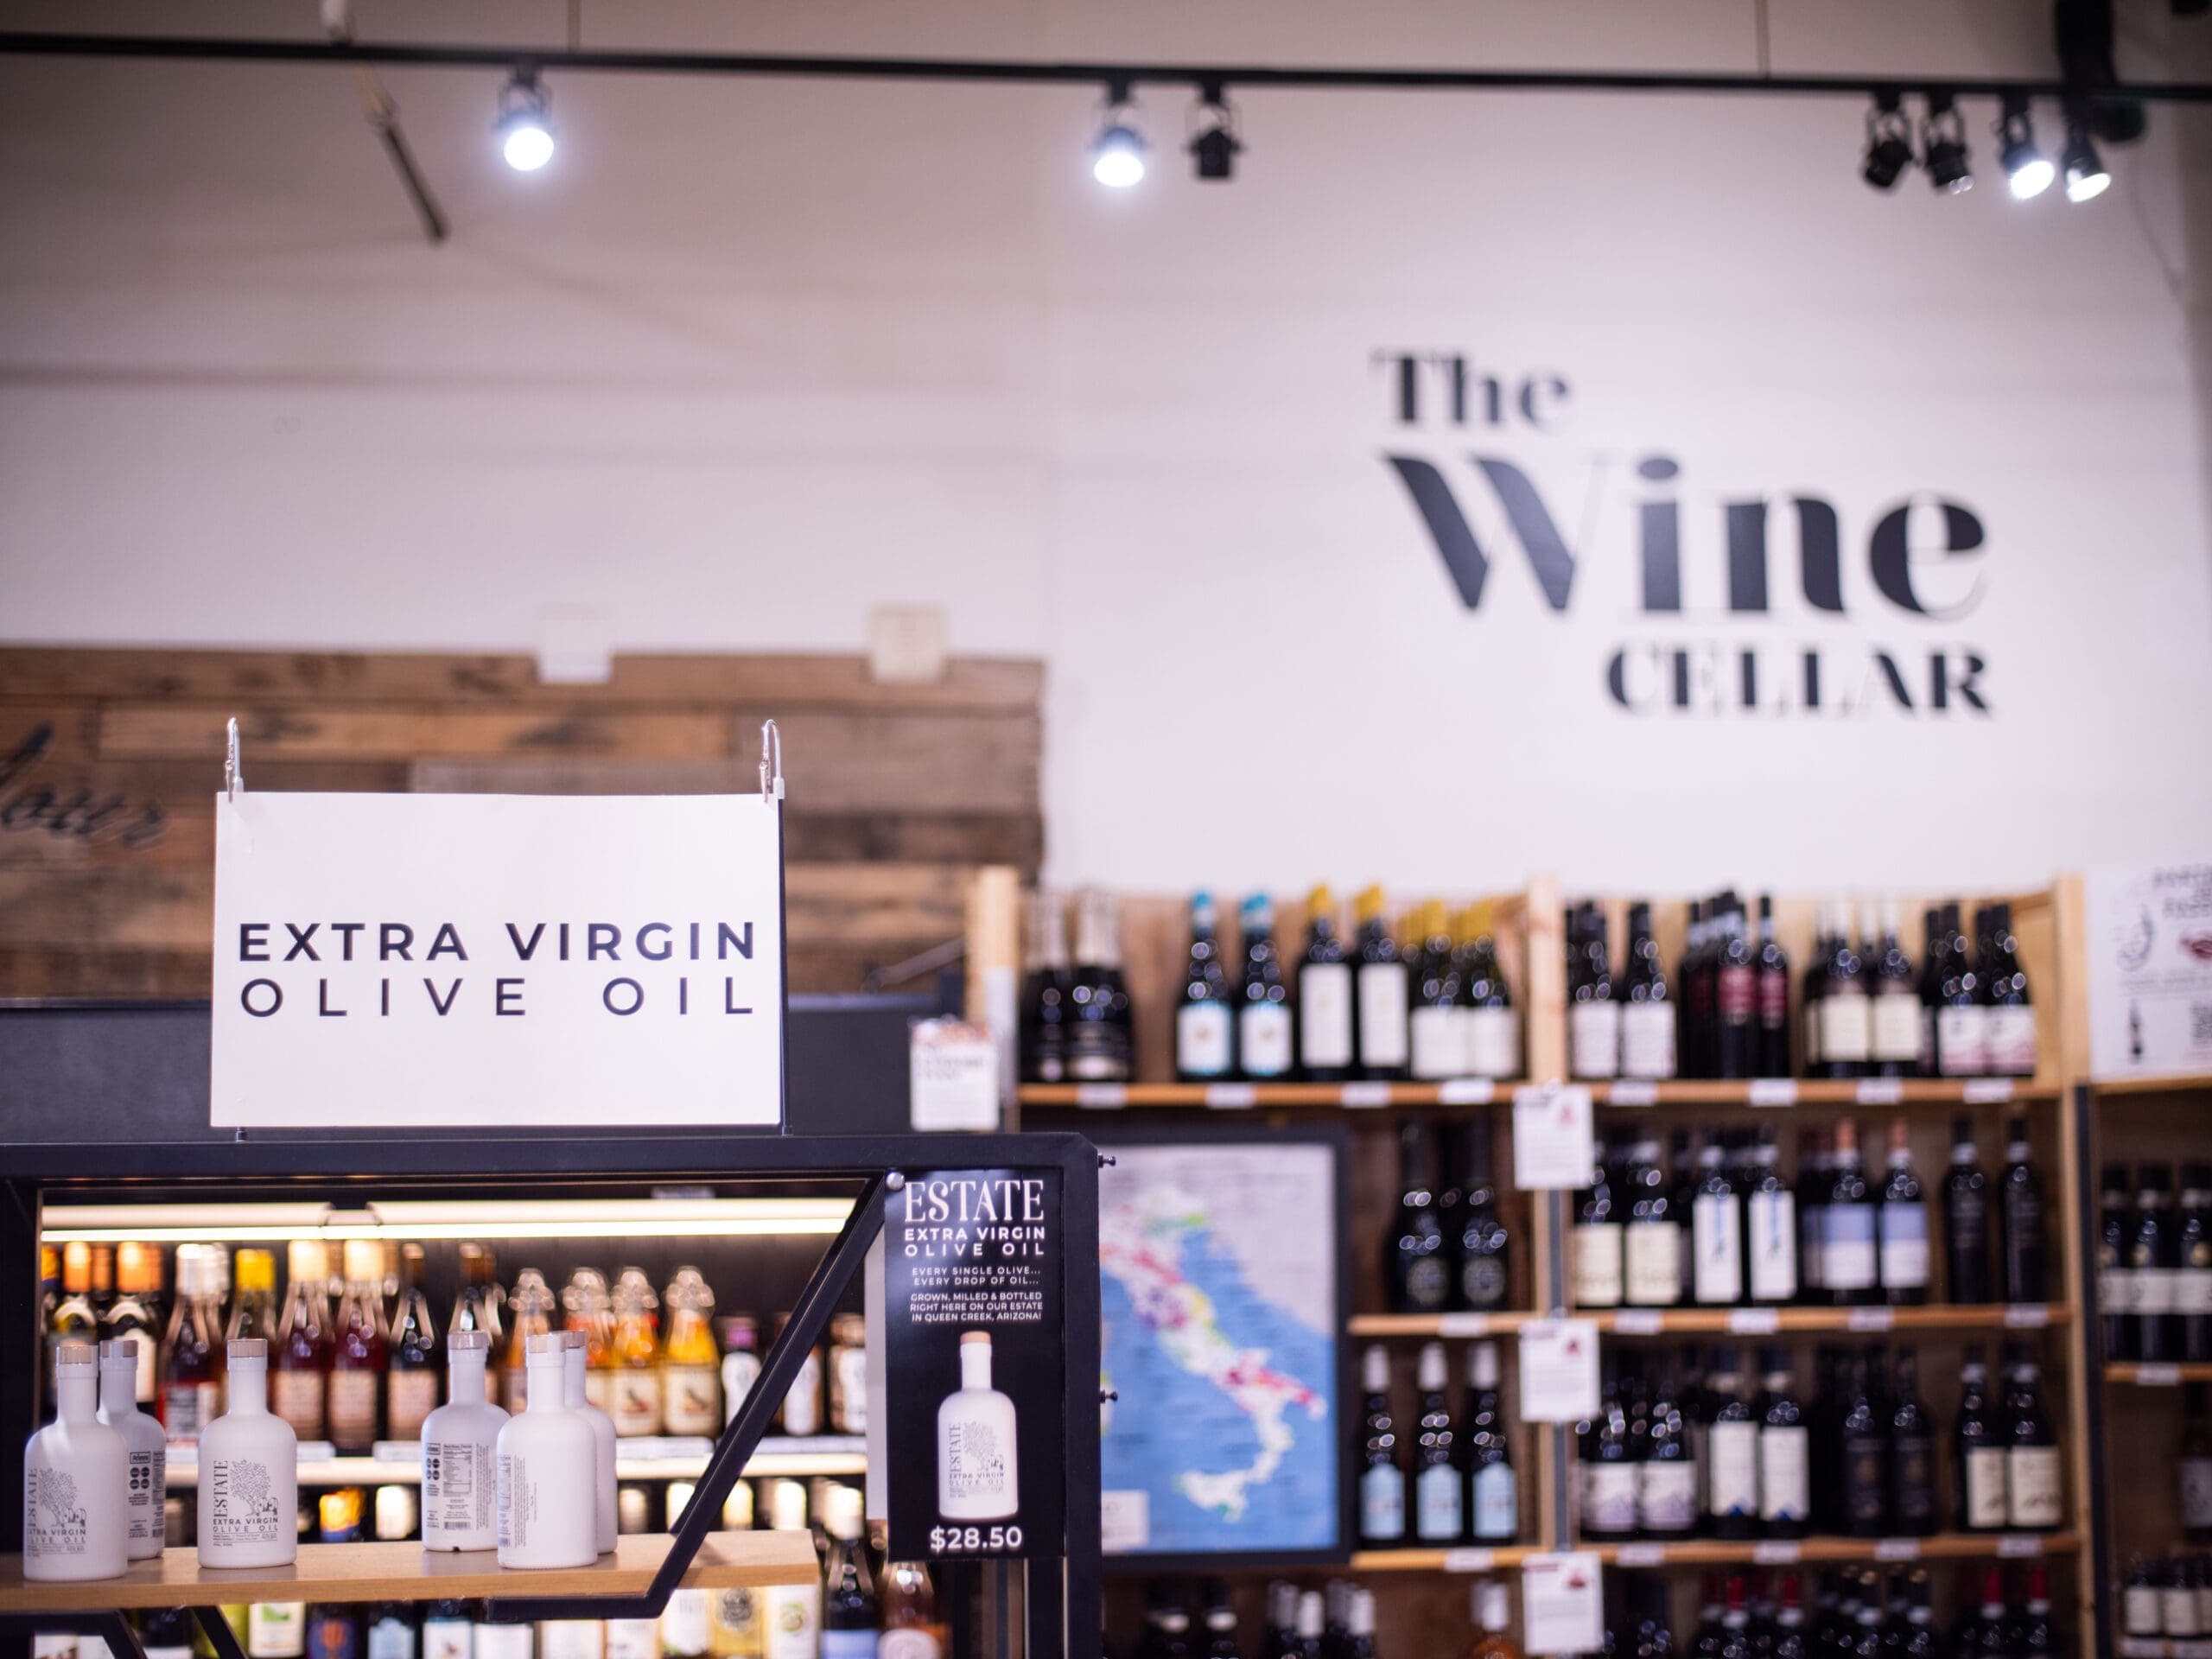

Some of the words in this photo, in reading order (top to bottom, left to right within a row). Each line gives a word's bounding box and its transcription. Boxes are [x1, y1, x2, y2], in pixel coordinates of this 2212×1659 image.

[1370, 352, 1570, 425] The
[1380, 453, 1986, 620] Wine
[1605, 643, 1992, 715] CELLAR
[239, 922, 468, 961] EXTRA
[505, 921, 753, 960] VIRGIN
[240, 977, 525, 1017] OLIVE
[602, 976, 753, 1016] OIL
[905, 1179, 1045, 1223] ESTATE
[905, 1227, 968, 1242] EXTRA
[976, 1226, 1045, 1240] VIRGIN
[905, 1243, 983, 1257] OLIVE
[1001, 1242, 1045, 1256] OIL
[912, 1267, 948, 1276] EVERY
[952, 1267, 993, 1275] SINGLE
[997, 1266, 1040, 1275] OLIVE...
[913, 1277, 950, 1286] EVERY
[954, 1277, 986, 1286] DROP
[990, 1276, 1006, 1285] OF
[1009, 1276, 1039, 1285] OIL...
[911, 1293, 950, 1302] GROWN,
[953, 1293, 988, 1301] MILLED
[990, 1292, 997, 1300] &
[999, 1292, 1042, 1300] BOTTLED
[910, 1303, 939, 1312] RIGHT
[941, 1303, 967, 1312] HERE
[969, 1302, 983, 1311] ON
[986, 1302, 1007, 1311] OUR
[1009, 1301, 1043, 1311] ESTATE
[912, 1313, 922, 1322] IN
[925, 1313, 958, 1323] QUEEN
[960, 1313, 995, 1322] CREEK,
[996, 1312, 1042, 1321] ARIZONA!
[949, 1422, 962, 1473] ESTATE
[213, 1460, 228, 1517] ESTATE
[50, 1528, 86, 1536] VIRGIN
[258, 1523, 278, 1532] OIL
[64, 1535, 86, 1544] OIL
[929, 1524, 1023, 1553] $28.50
